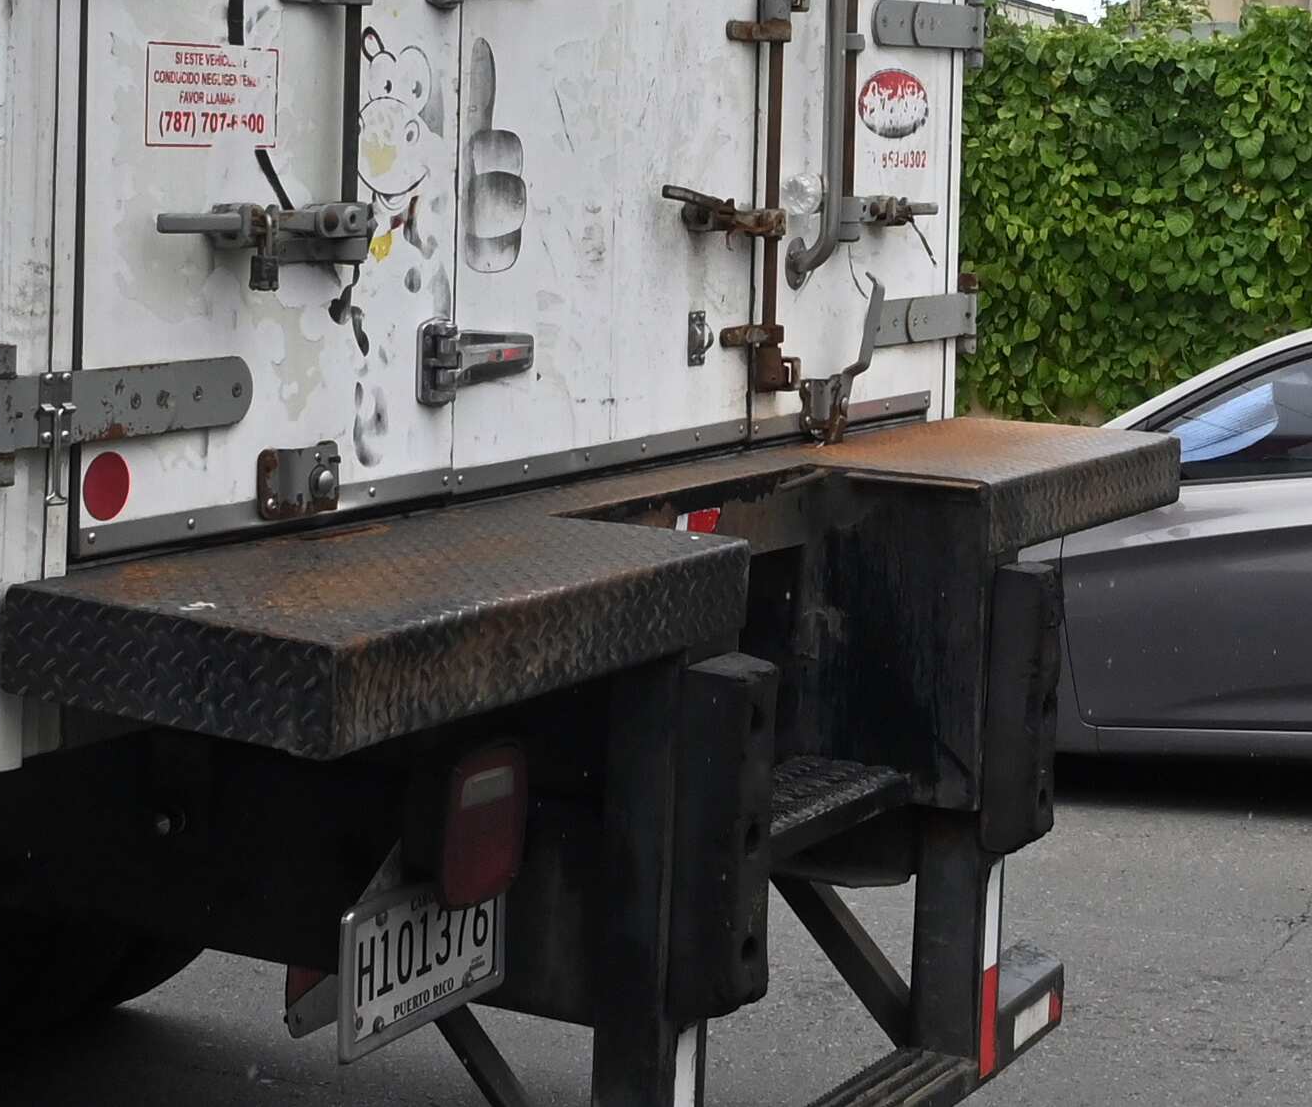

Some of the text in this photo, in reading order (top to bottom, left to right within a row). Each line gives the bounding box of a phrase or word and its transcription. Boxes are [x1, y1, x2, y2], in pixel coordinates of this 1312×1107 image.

[176, 52, 183, 63] SI
[183, 53, 204, 65] ESTE
[154, 71, 200, 85] CONDUCIDO
[179, 92, 204, 104] FAVOR
[159, 111, 196, 137] (787)
[393, 977, 455, 1020] PUERTO RICO
